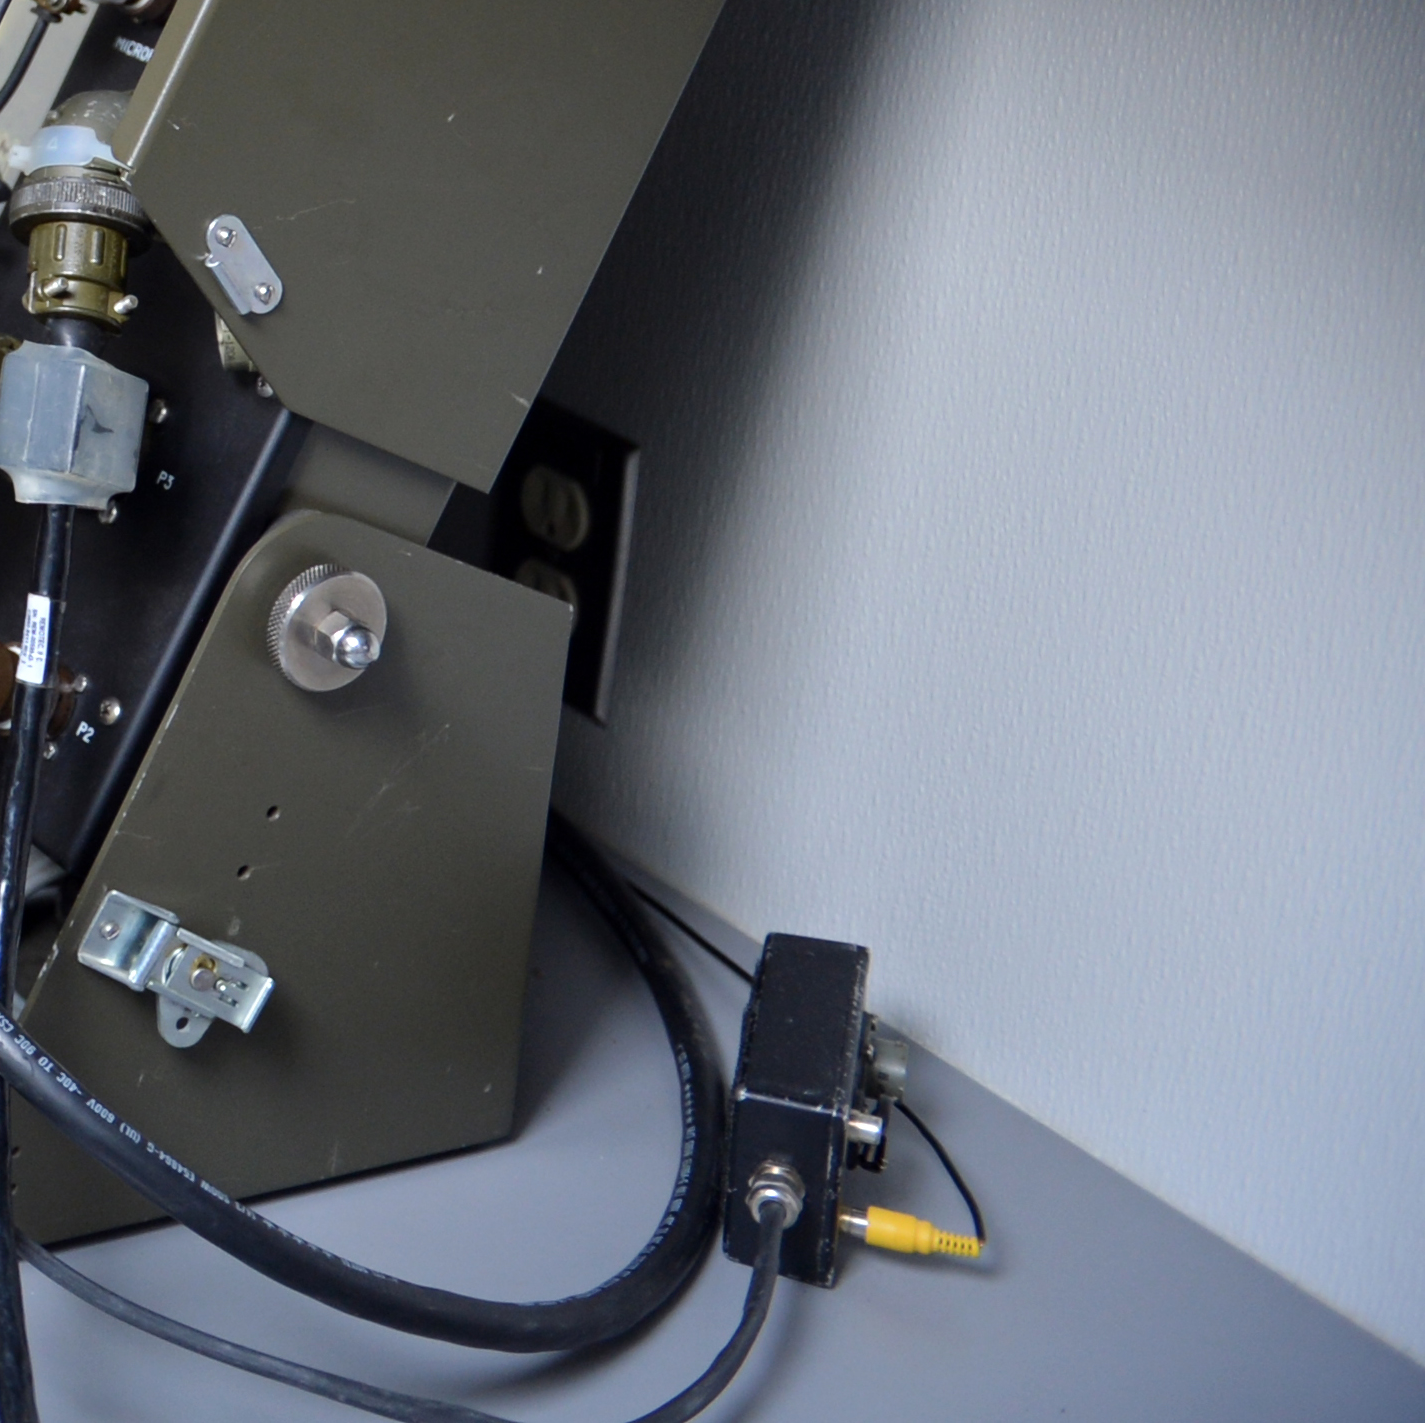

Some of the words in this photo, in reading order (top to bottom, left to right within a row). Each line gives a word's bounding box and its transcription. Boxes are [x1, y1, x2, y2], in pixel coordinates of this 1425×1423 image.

[156, 469, 176, 491] P3
[75, 720, 96, 744] P2
[13, 1035, 37, 1056] 90C
[37, 1055, 55, 1073] TO
[55, 1072, 84, 1096] -40C
[86, 1097, 116, 1124] 600V
[119, 1122, 142, 1144] (UL)
